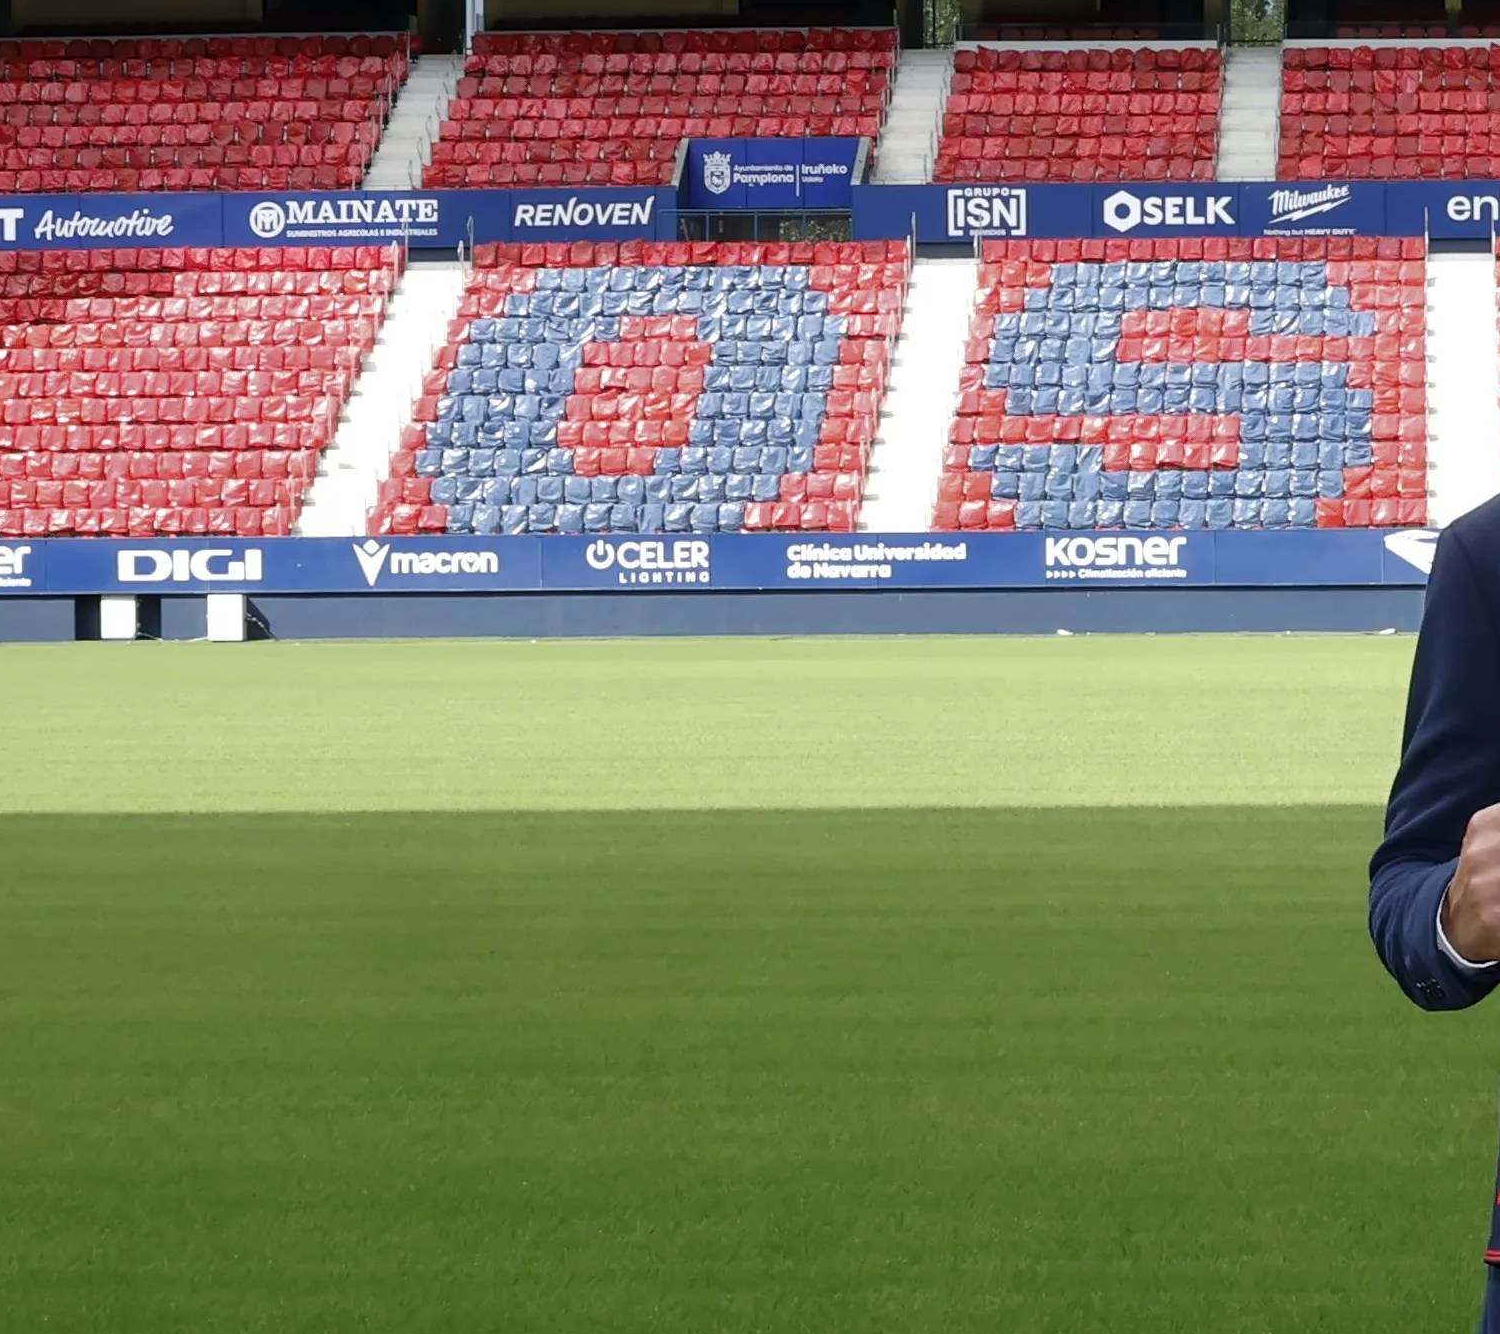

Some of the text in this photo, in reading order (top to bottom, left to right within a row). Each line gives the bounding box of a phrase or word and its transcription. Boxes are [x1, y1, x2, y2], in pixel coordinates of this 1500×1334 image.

[733, 174, 793, 185] Pamplona
[802, 163, 847, 175] Iruñeko
[964, 187, 1010, 197] GRUPO
[1268, 184, 1350, 215] Milwaukee
[286, 200, 438, 222] MAINATE
[514, 196, 655, 227] RENOVEN
[957, 198, 1018, 227] ISN
[1143, 196, 1235, 225] SELK
[34, 208, 173, 242] Automotive
[391, 551, 498, 574] macron
[616, 541, 709, 569] CELER
[787, 543, 967, 561] Clínica Universidad
[118, 549, 262, 581] DIGI
[787, 561, 891, 578] de Navarra
[620, 572, 709, 583] LIGHTING
